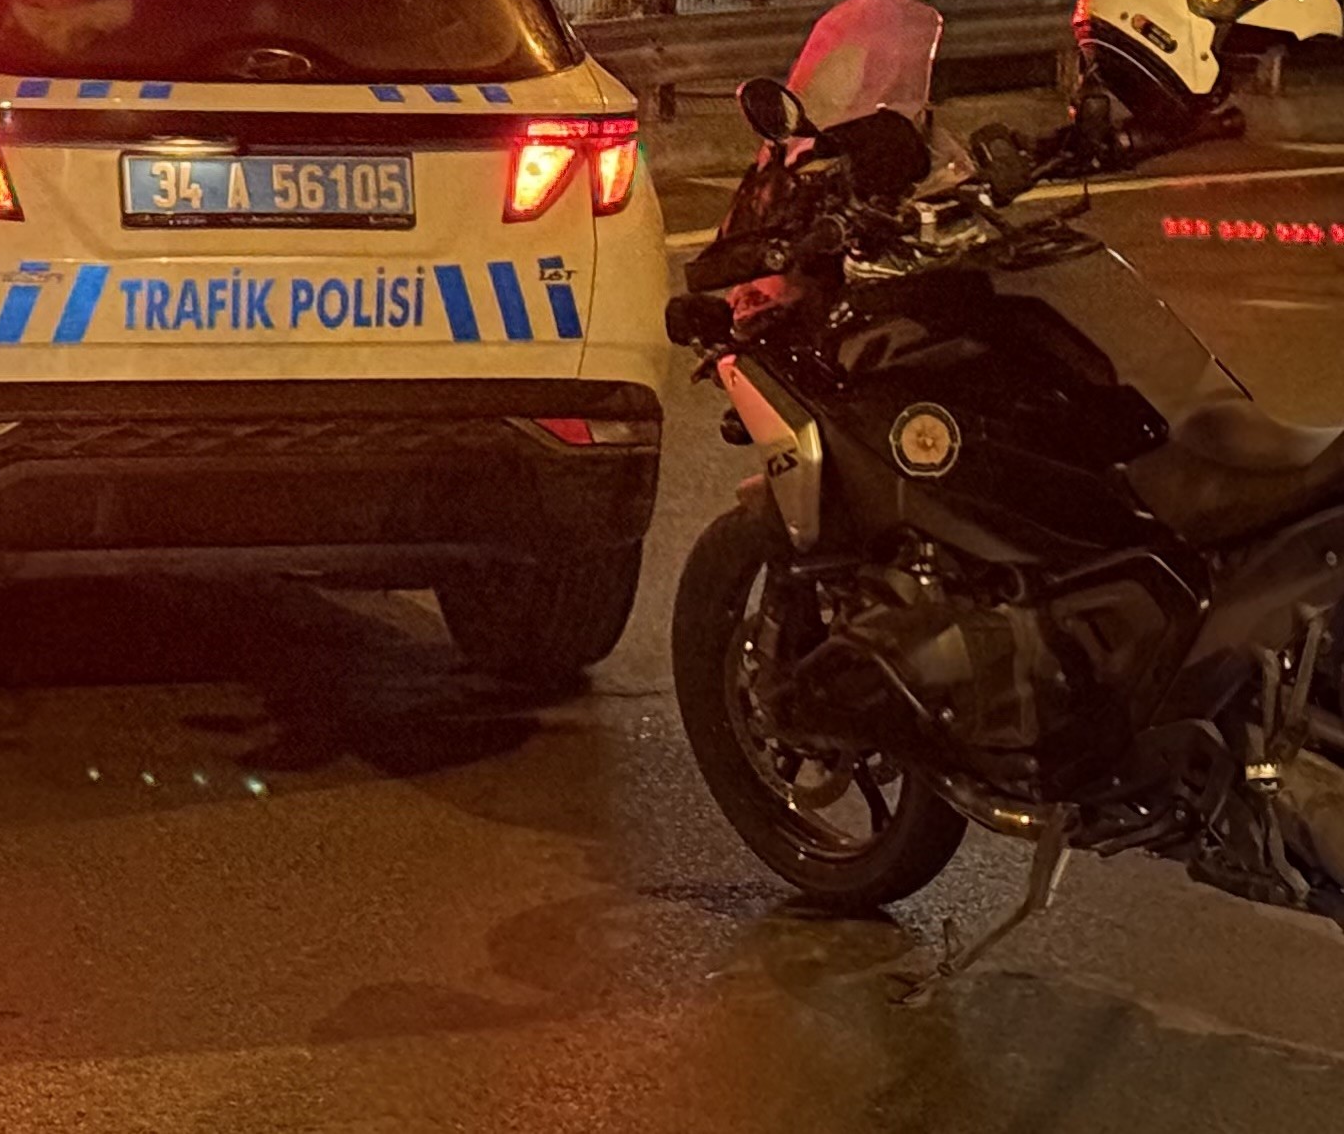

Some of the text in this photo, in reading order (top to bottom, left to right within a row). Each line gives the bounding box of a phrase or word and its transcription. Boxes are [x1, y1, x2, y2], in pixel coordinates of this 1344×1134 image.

[151, 161, 404, 210] 34 A 56105
[120, 267, 425, 330] TRAFİK POLİSİ
